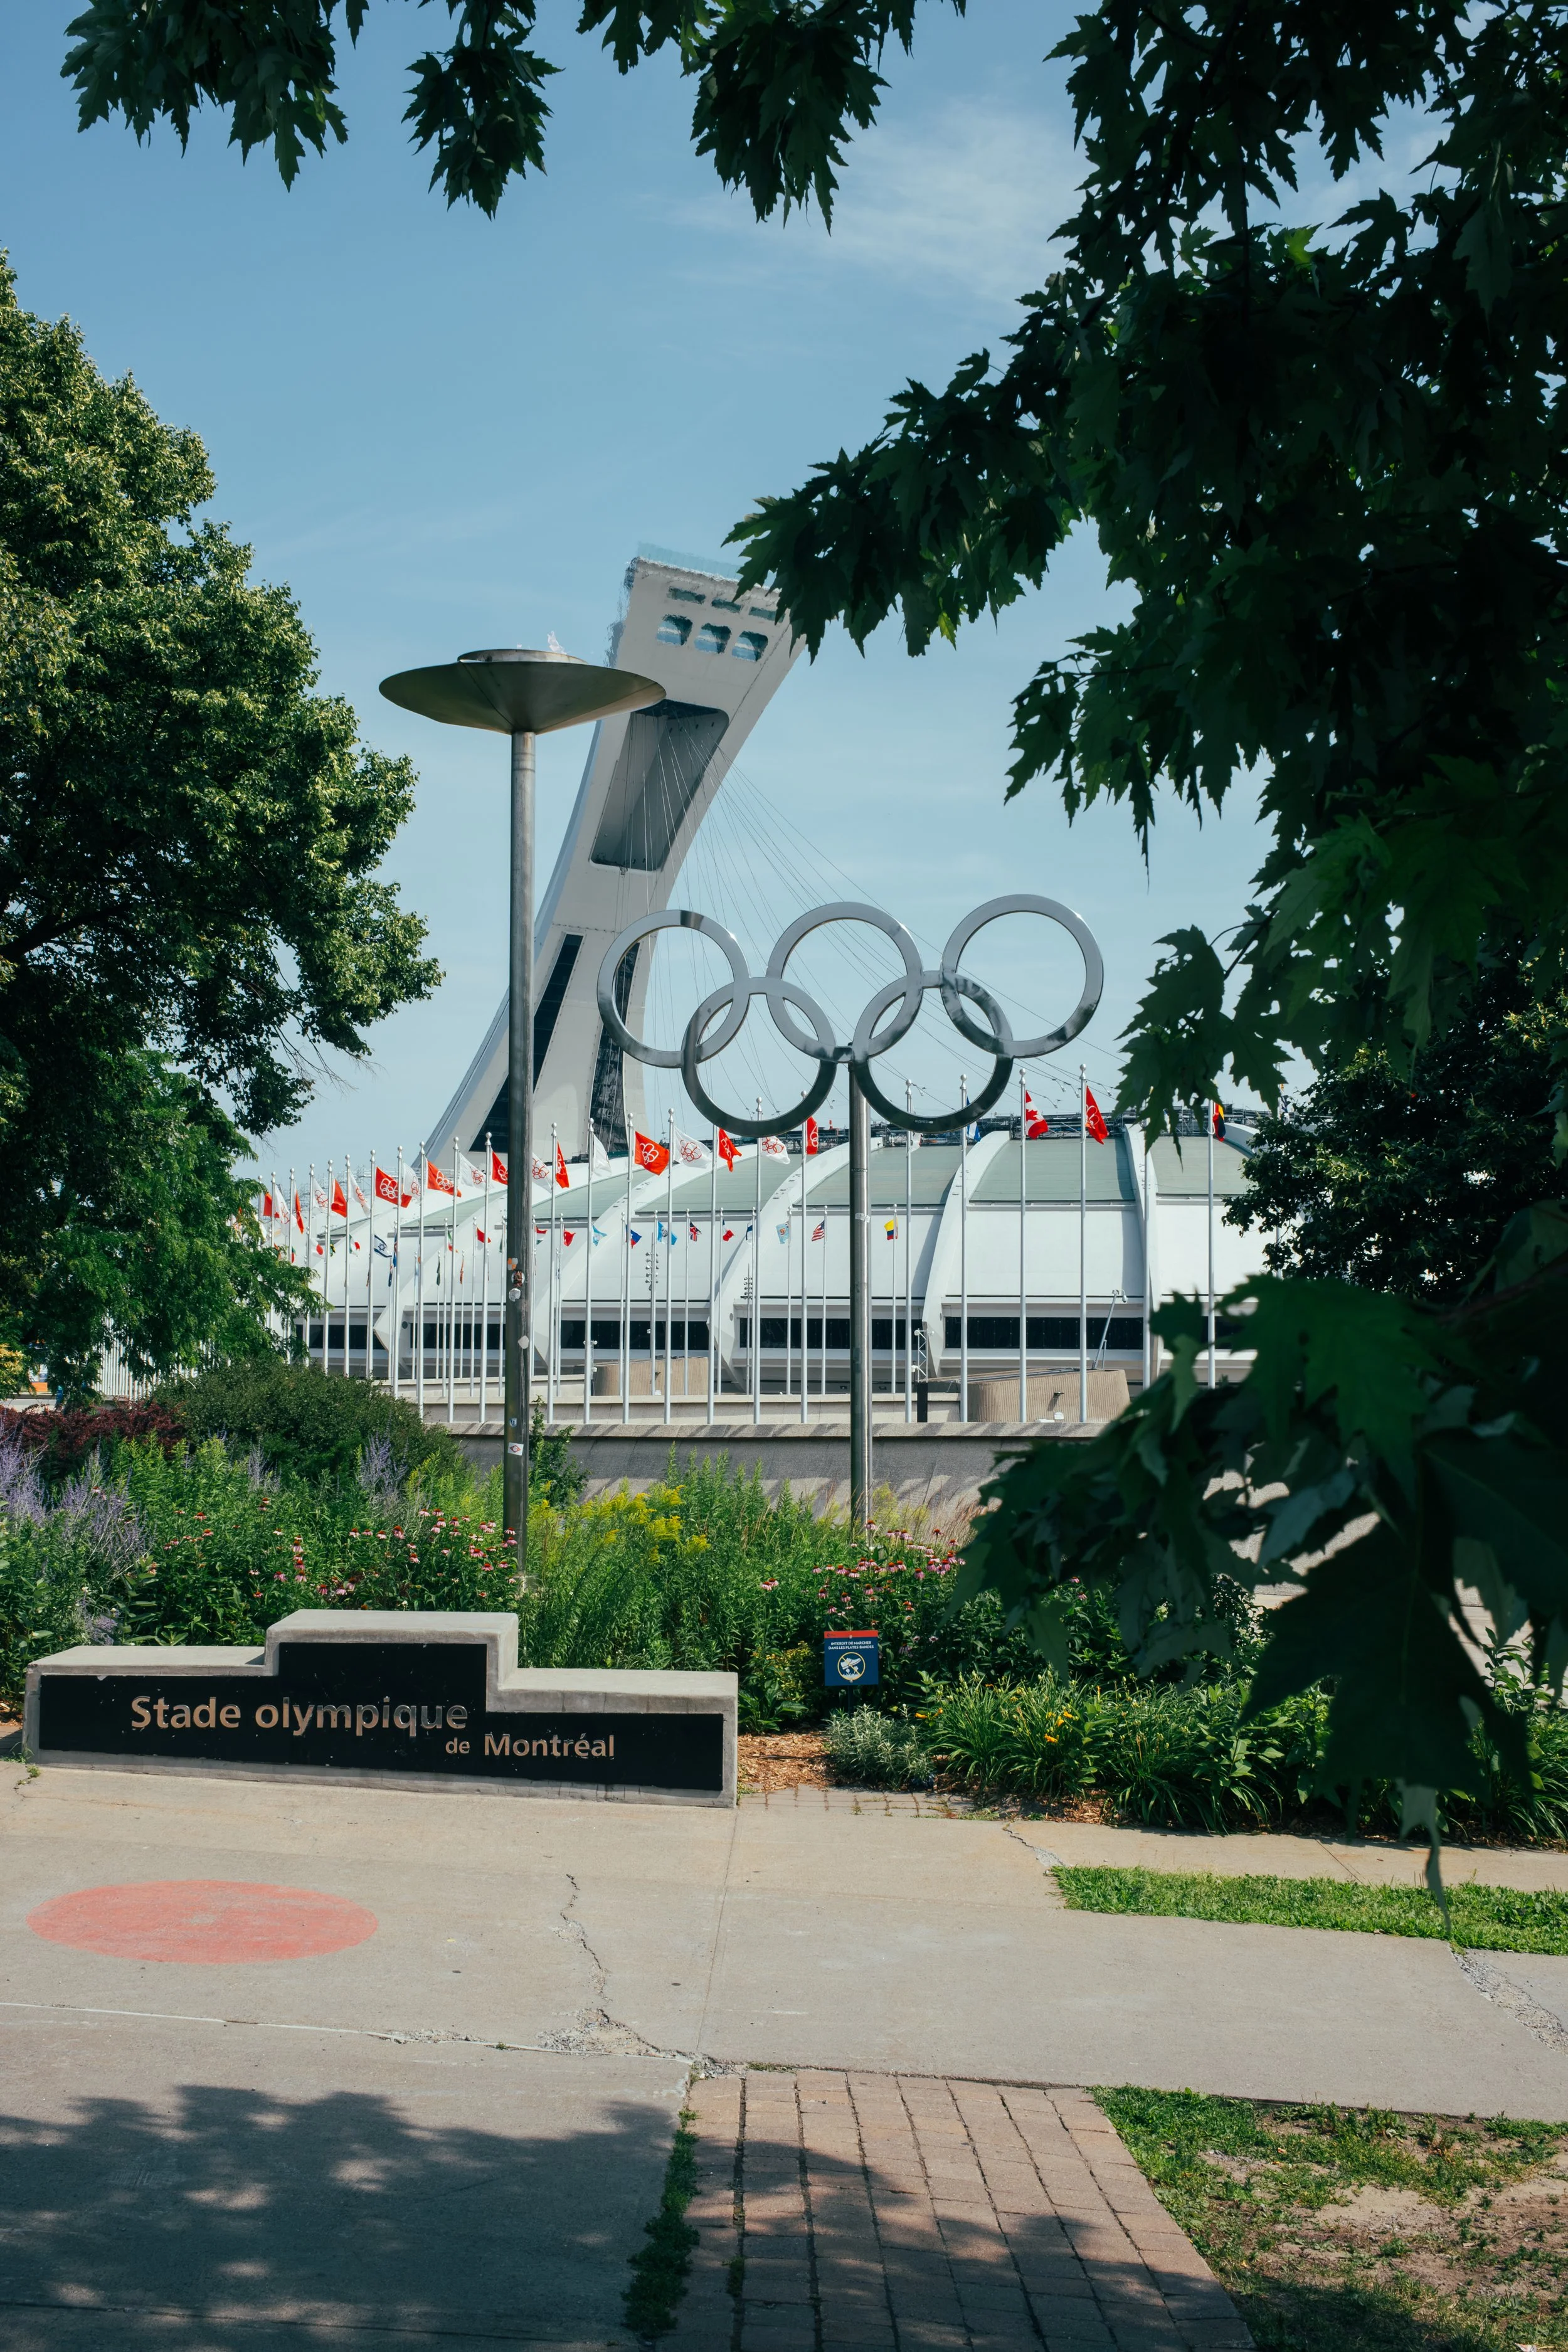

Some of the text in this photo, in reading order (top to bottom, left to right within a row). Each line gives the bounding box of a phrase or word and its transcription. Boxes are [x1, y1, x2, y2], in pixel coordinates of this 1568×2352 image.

[131, 1695, 469, 1737] Stade olympique
[445, 1732, 615, 1758] de Montréal
